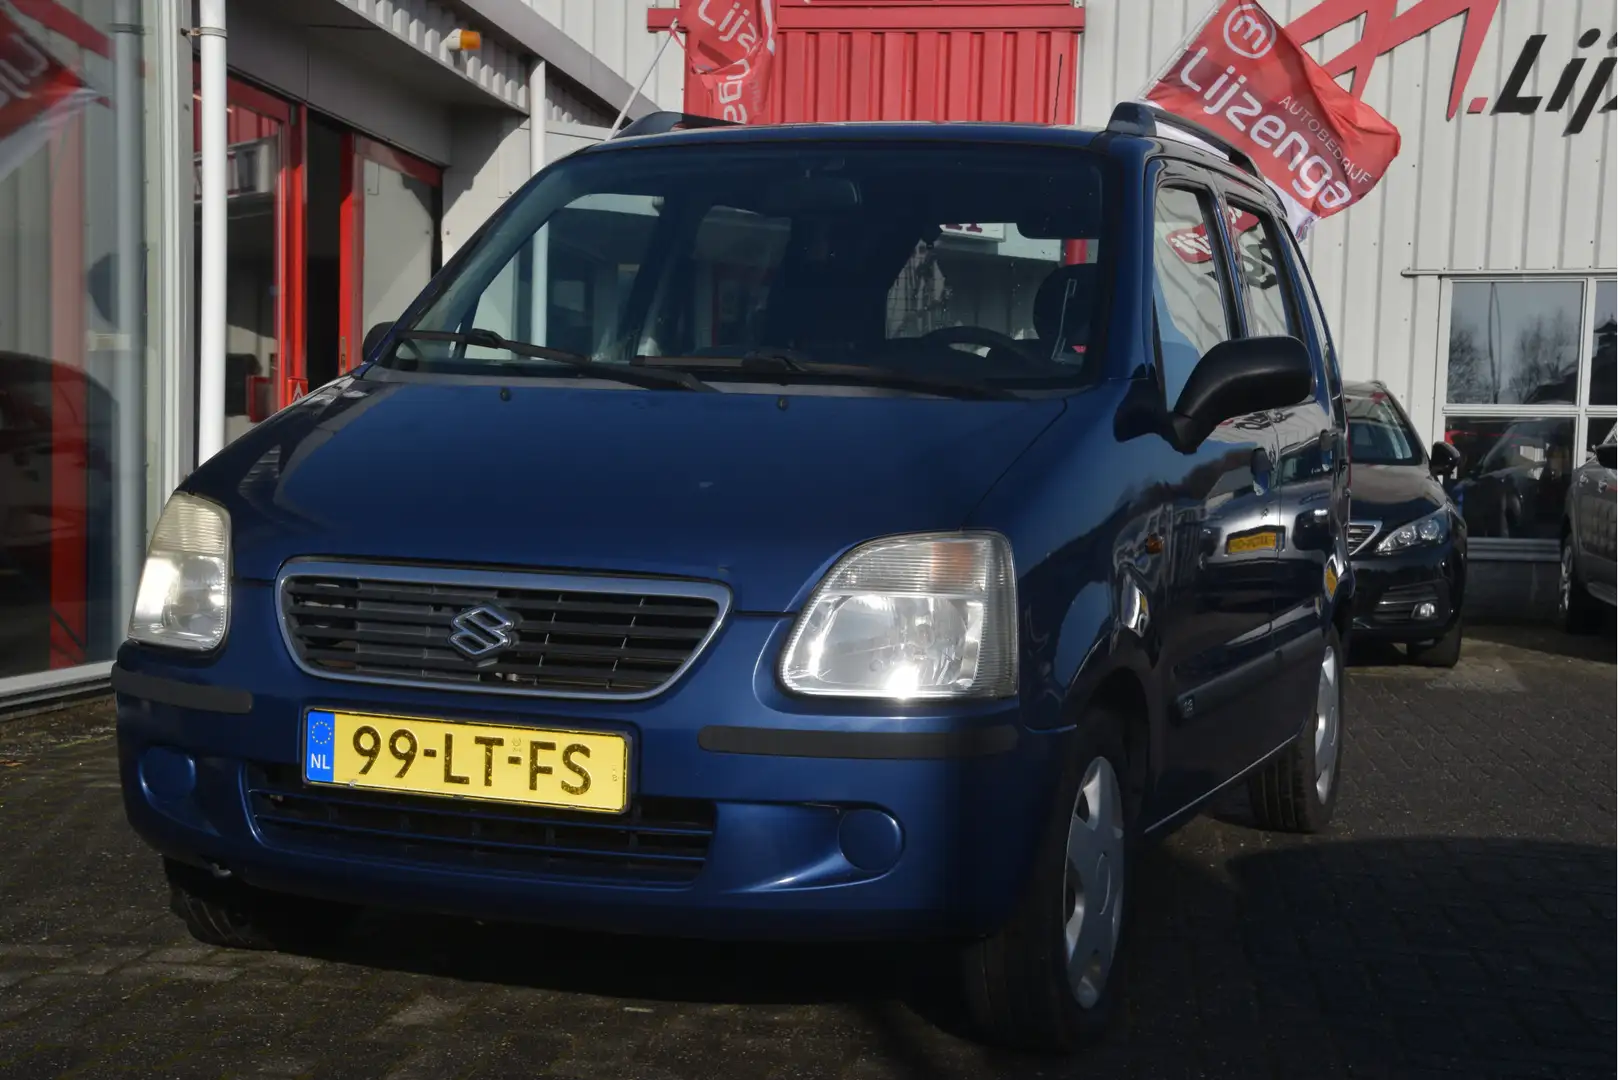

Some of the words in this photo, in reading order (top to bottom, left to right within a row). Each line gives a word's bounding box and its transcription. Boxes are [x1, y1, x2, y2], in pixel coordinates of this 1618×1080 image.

[1180, 46, 1353, 209] Lijzenga
[1278, 95, 1373, 185] AUTOBEDRIJF
[311, 752, 331, 770] NL
[352, 724, 593, 796] 99-LT-FS
